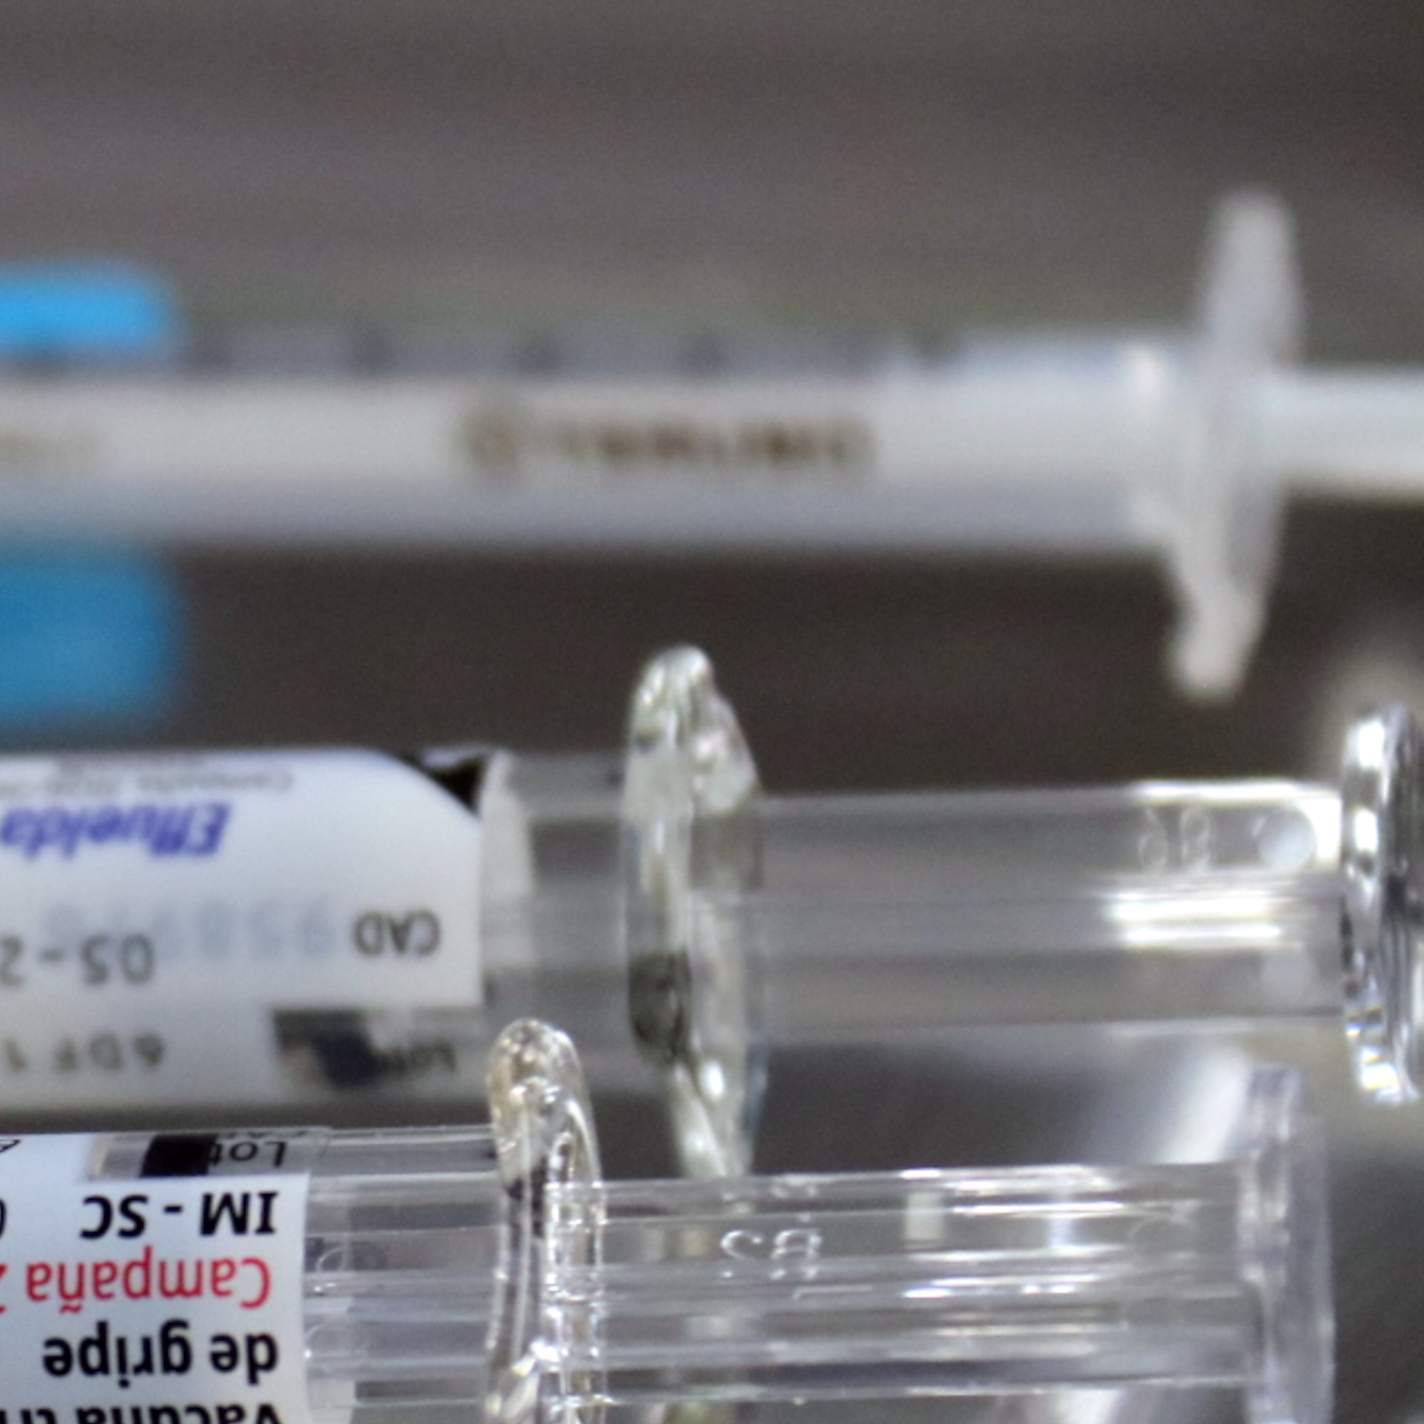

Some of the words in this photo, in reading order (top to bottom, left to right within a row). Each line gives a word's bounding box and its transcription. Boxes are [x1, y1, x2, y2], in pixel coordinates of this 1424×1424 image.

[353, 909, 442, 958] CAD
[80, 1194, 150, 1240] SC
[199, 1190, 279, 1236] IM
[25, 1244, 273, 1310] Campaña
[41, 1318, 194, 1384] gripe
[209, 1334, 279, 1382] de
